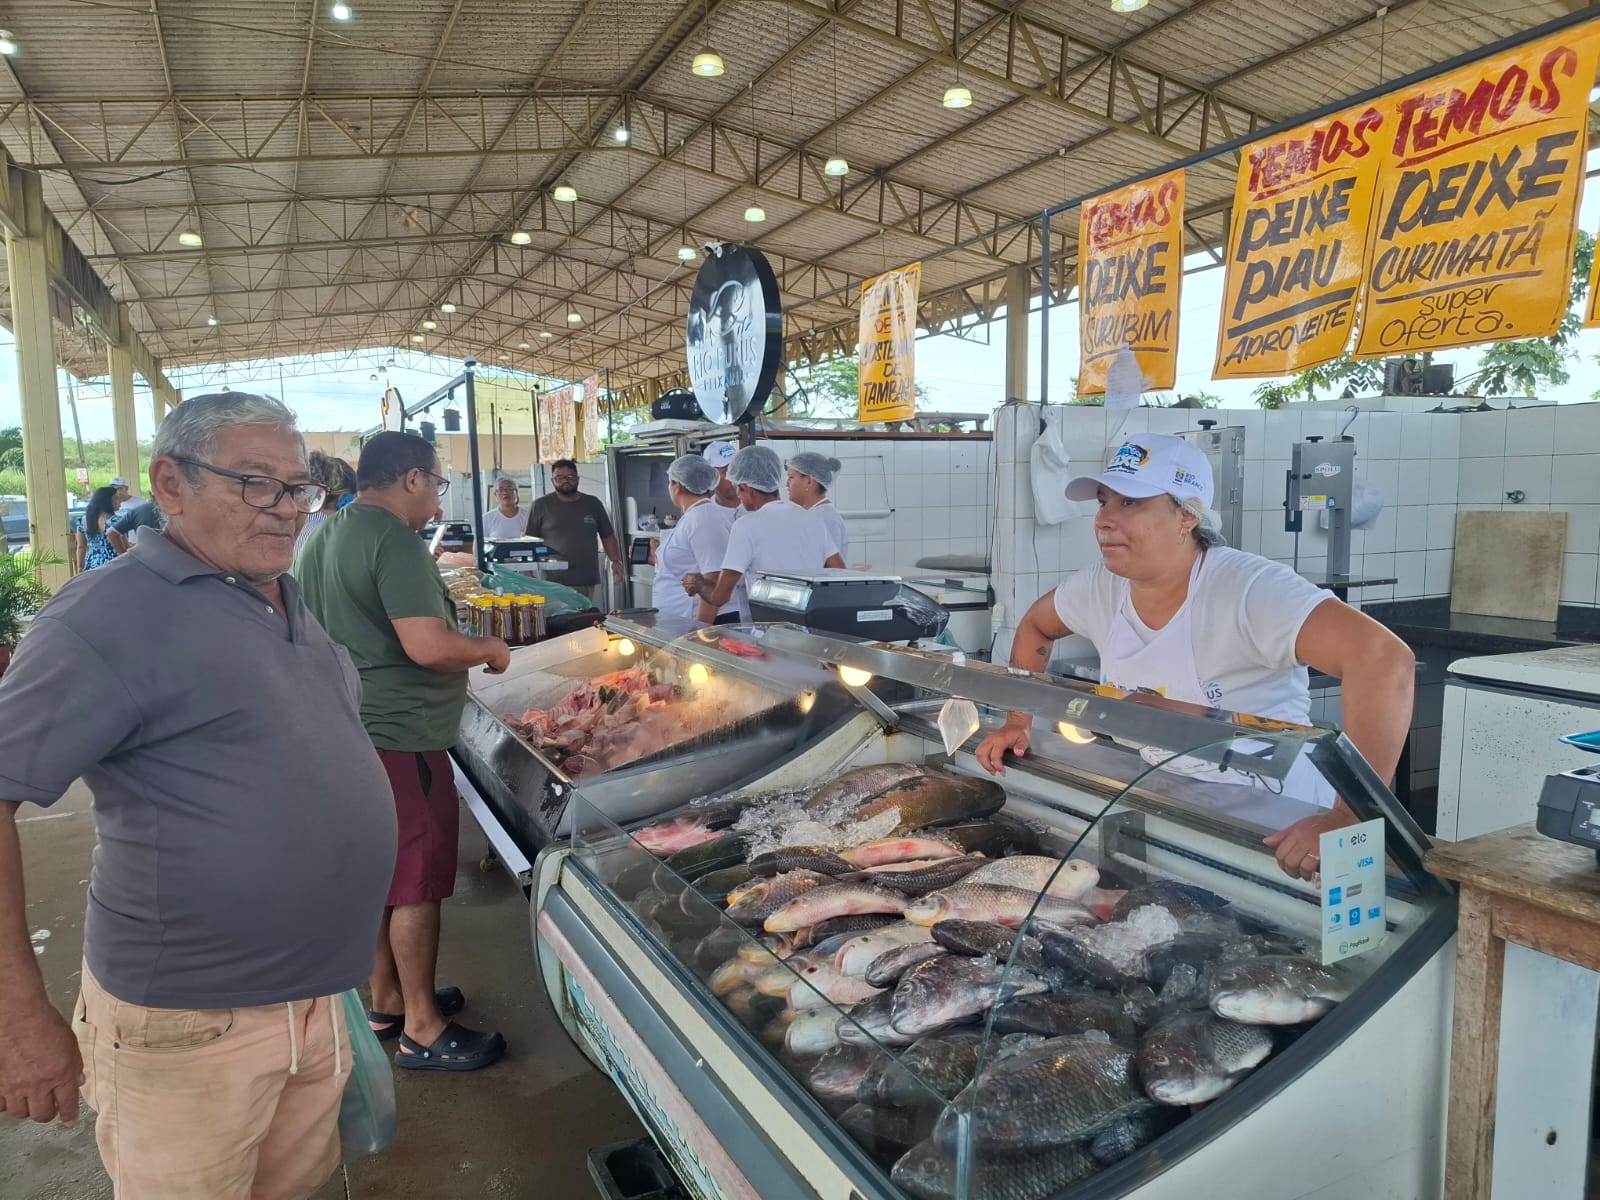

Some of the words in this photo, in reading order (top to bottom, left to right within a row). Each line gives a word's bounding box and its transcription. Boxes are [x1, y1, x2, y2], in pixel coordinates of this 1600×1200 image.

[1391, 45, 1578, 158] TEMOS
[1248, 107, 1383, 192] TEMOS
[1380, 130, 1579, 241] PEIXE
[1083, 180, 1179, 246] TEMOS
[1236, 177, 1357, 262] PEIXE
[1371, 203, 1558, 292] CURIMATÃ
[1085, 242, 1169, 314] PEIXE
[1232, 239, 1341, 320] PIAU
[1085, 309, 1172, 354] SURUBIM
[1223, 301, 1353, 367] APROVEITE
[1351, 832, 1367, 846] elo
[1357, 856, 1374, 868] VISA
